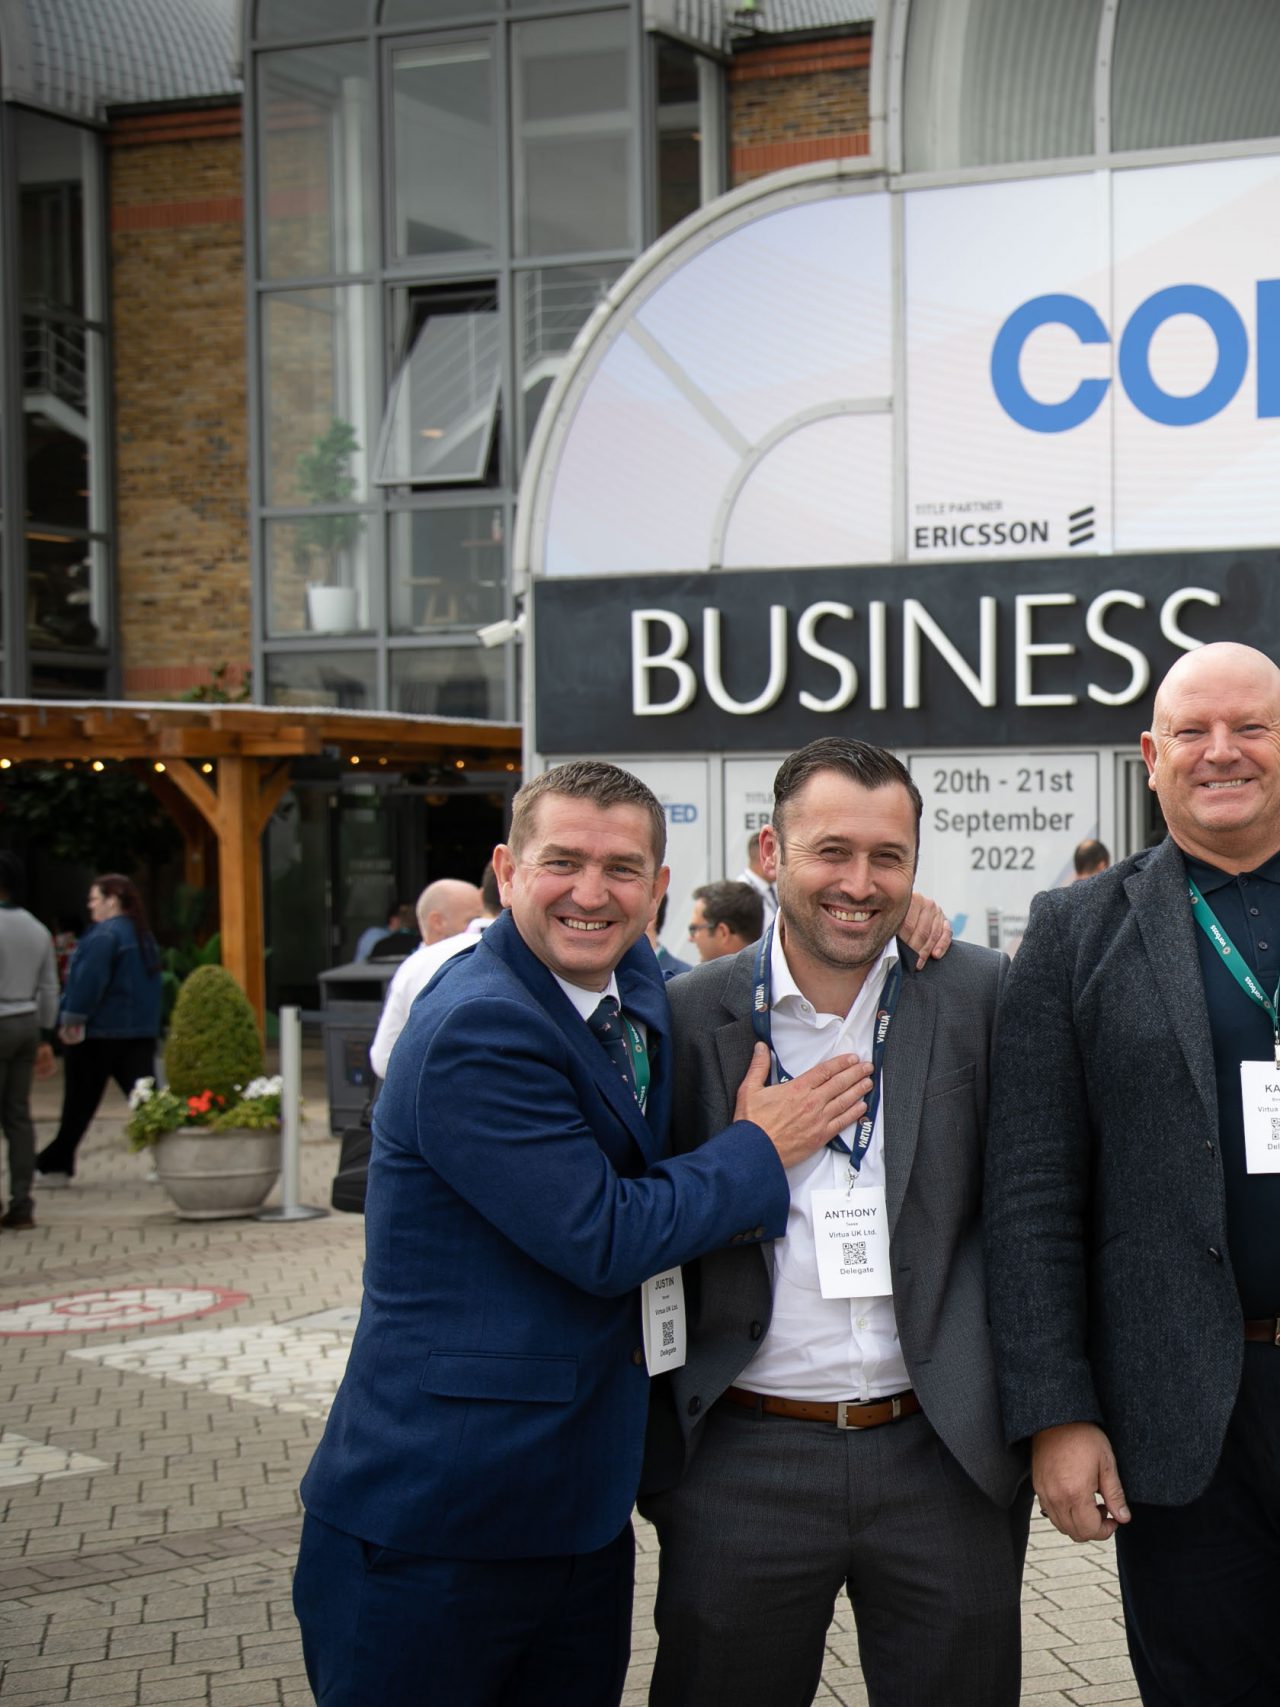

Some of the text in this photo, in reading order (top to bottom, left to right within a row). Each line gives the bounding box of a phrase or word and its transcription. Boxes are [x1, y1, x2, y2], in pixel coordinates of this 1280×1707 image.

[914, 521, 1049, 549] ERICSSON
[933, 768, 990, 794] 20th
[1016, 768, 1075, 793] 21st
[933, 806, 1075, 839] September
[970, 846, 1036, 871] 2022
[1257, 1105, 1279, 1113] Virtua
[824, 1207, 878, 1220] ANTHONY
[828, 1228, 877, 1239] Virtua UK Ltd.
[839, 1266, 875, 1275] Delegate
[654, 1276, 675, 1291] JUSTIN
